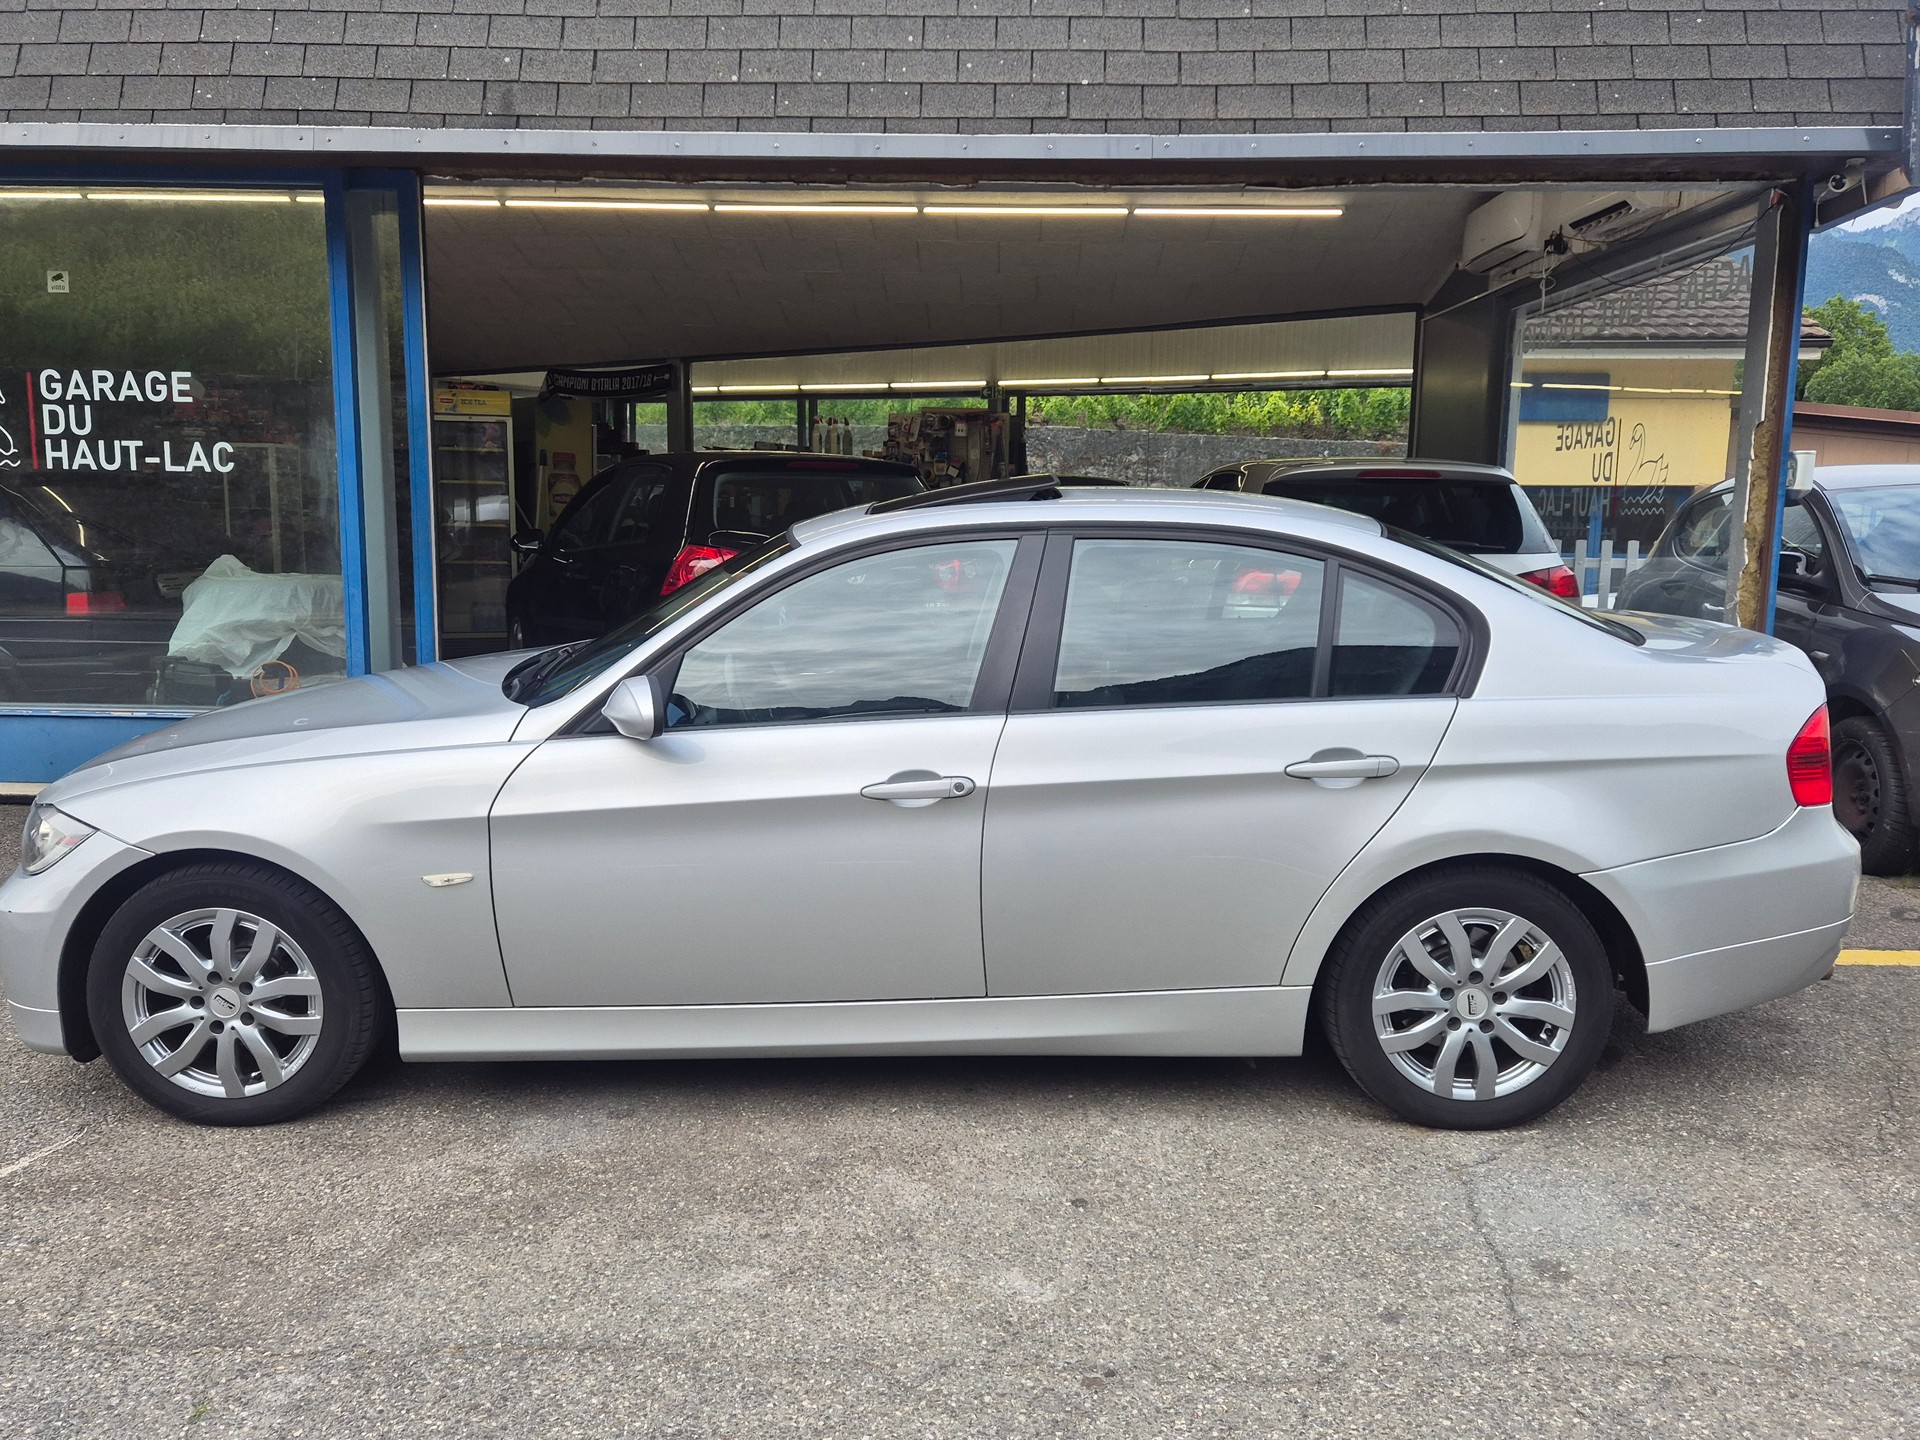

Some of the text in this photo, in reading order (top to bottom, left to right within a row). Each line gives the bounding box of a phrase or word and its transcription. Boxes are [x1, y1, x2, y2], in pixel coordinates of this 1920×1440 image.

[40, 369, 193, 402] GARAGE
[554, 373, 652, 391] CAMPIONI D'ITALIA 2017/18
[42, 404, 92, 435] DU
[45, 439, 235, 473] HAUT-LAC
